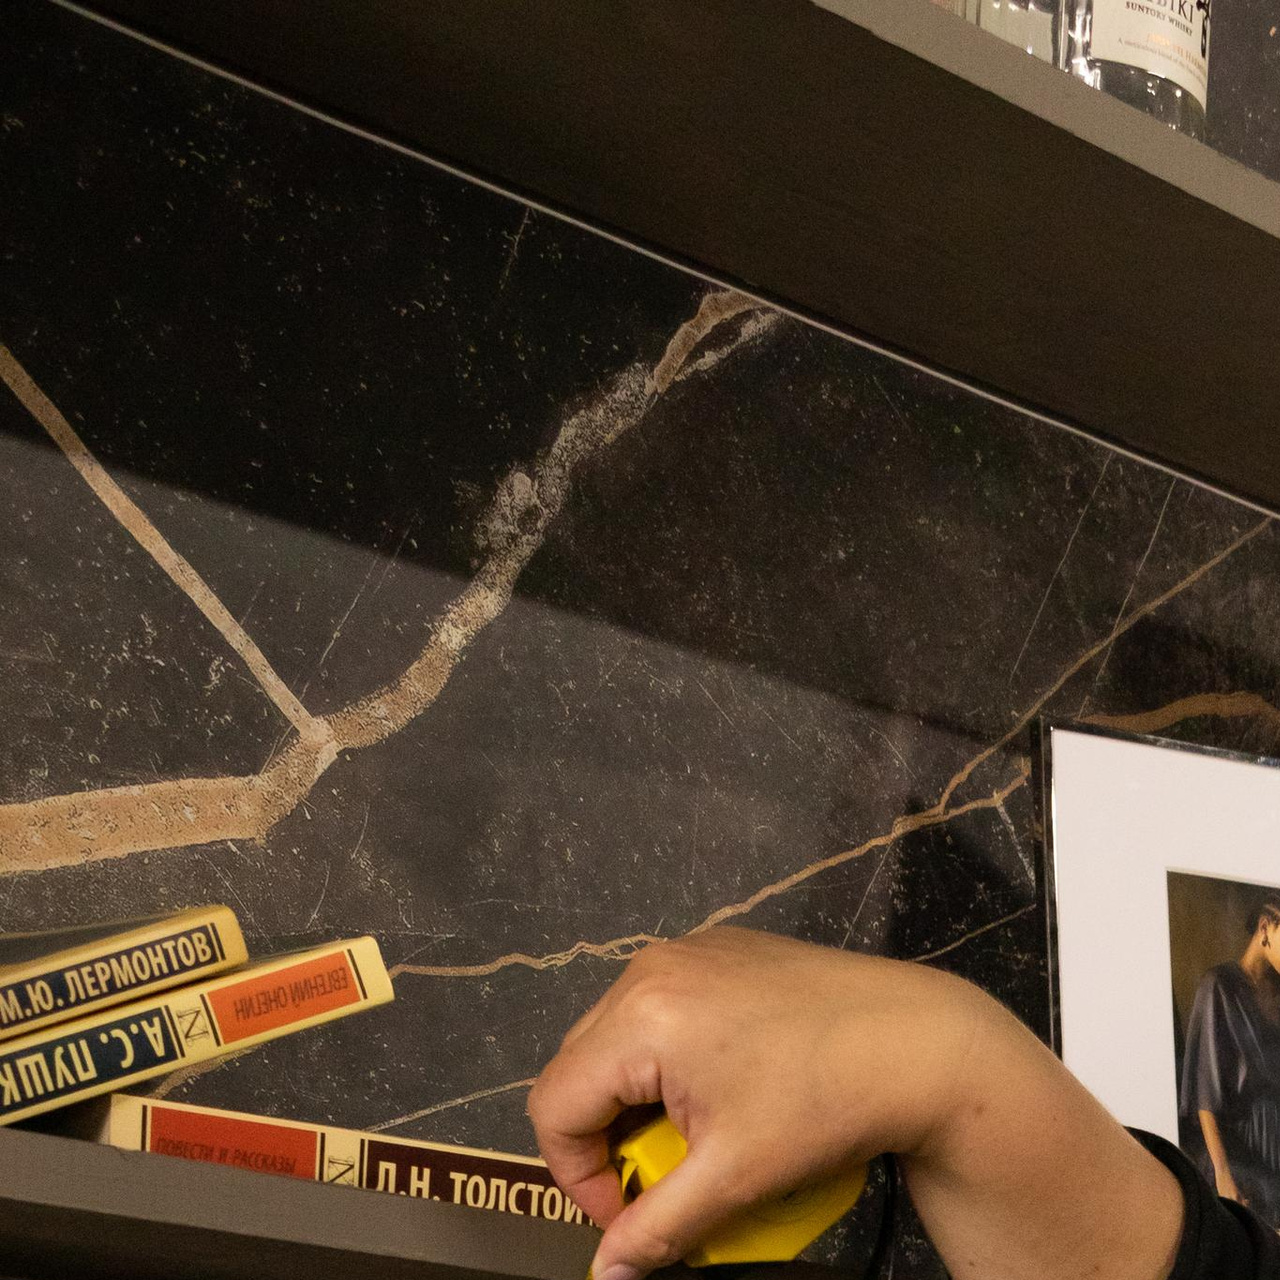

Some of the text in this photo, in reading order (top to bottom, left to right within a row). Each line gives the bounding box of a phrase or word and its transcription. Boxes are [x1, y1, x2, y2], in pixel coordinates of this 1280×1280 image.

[1125, 1, 1193, 36] SUNTORY WHISKY
[64, 932, 212, 1002] ЛЕРМОНТОВ
[100, 1016, 165, 1069] А.С.
